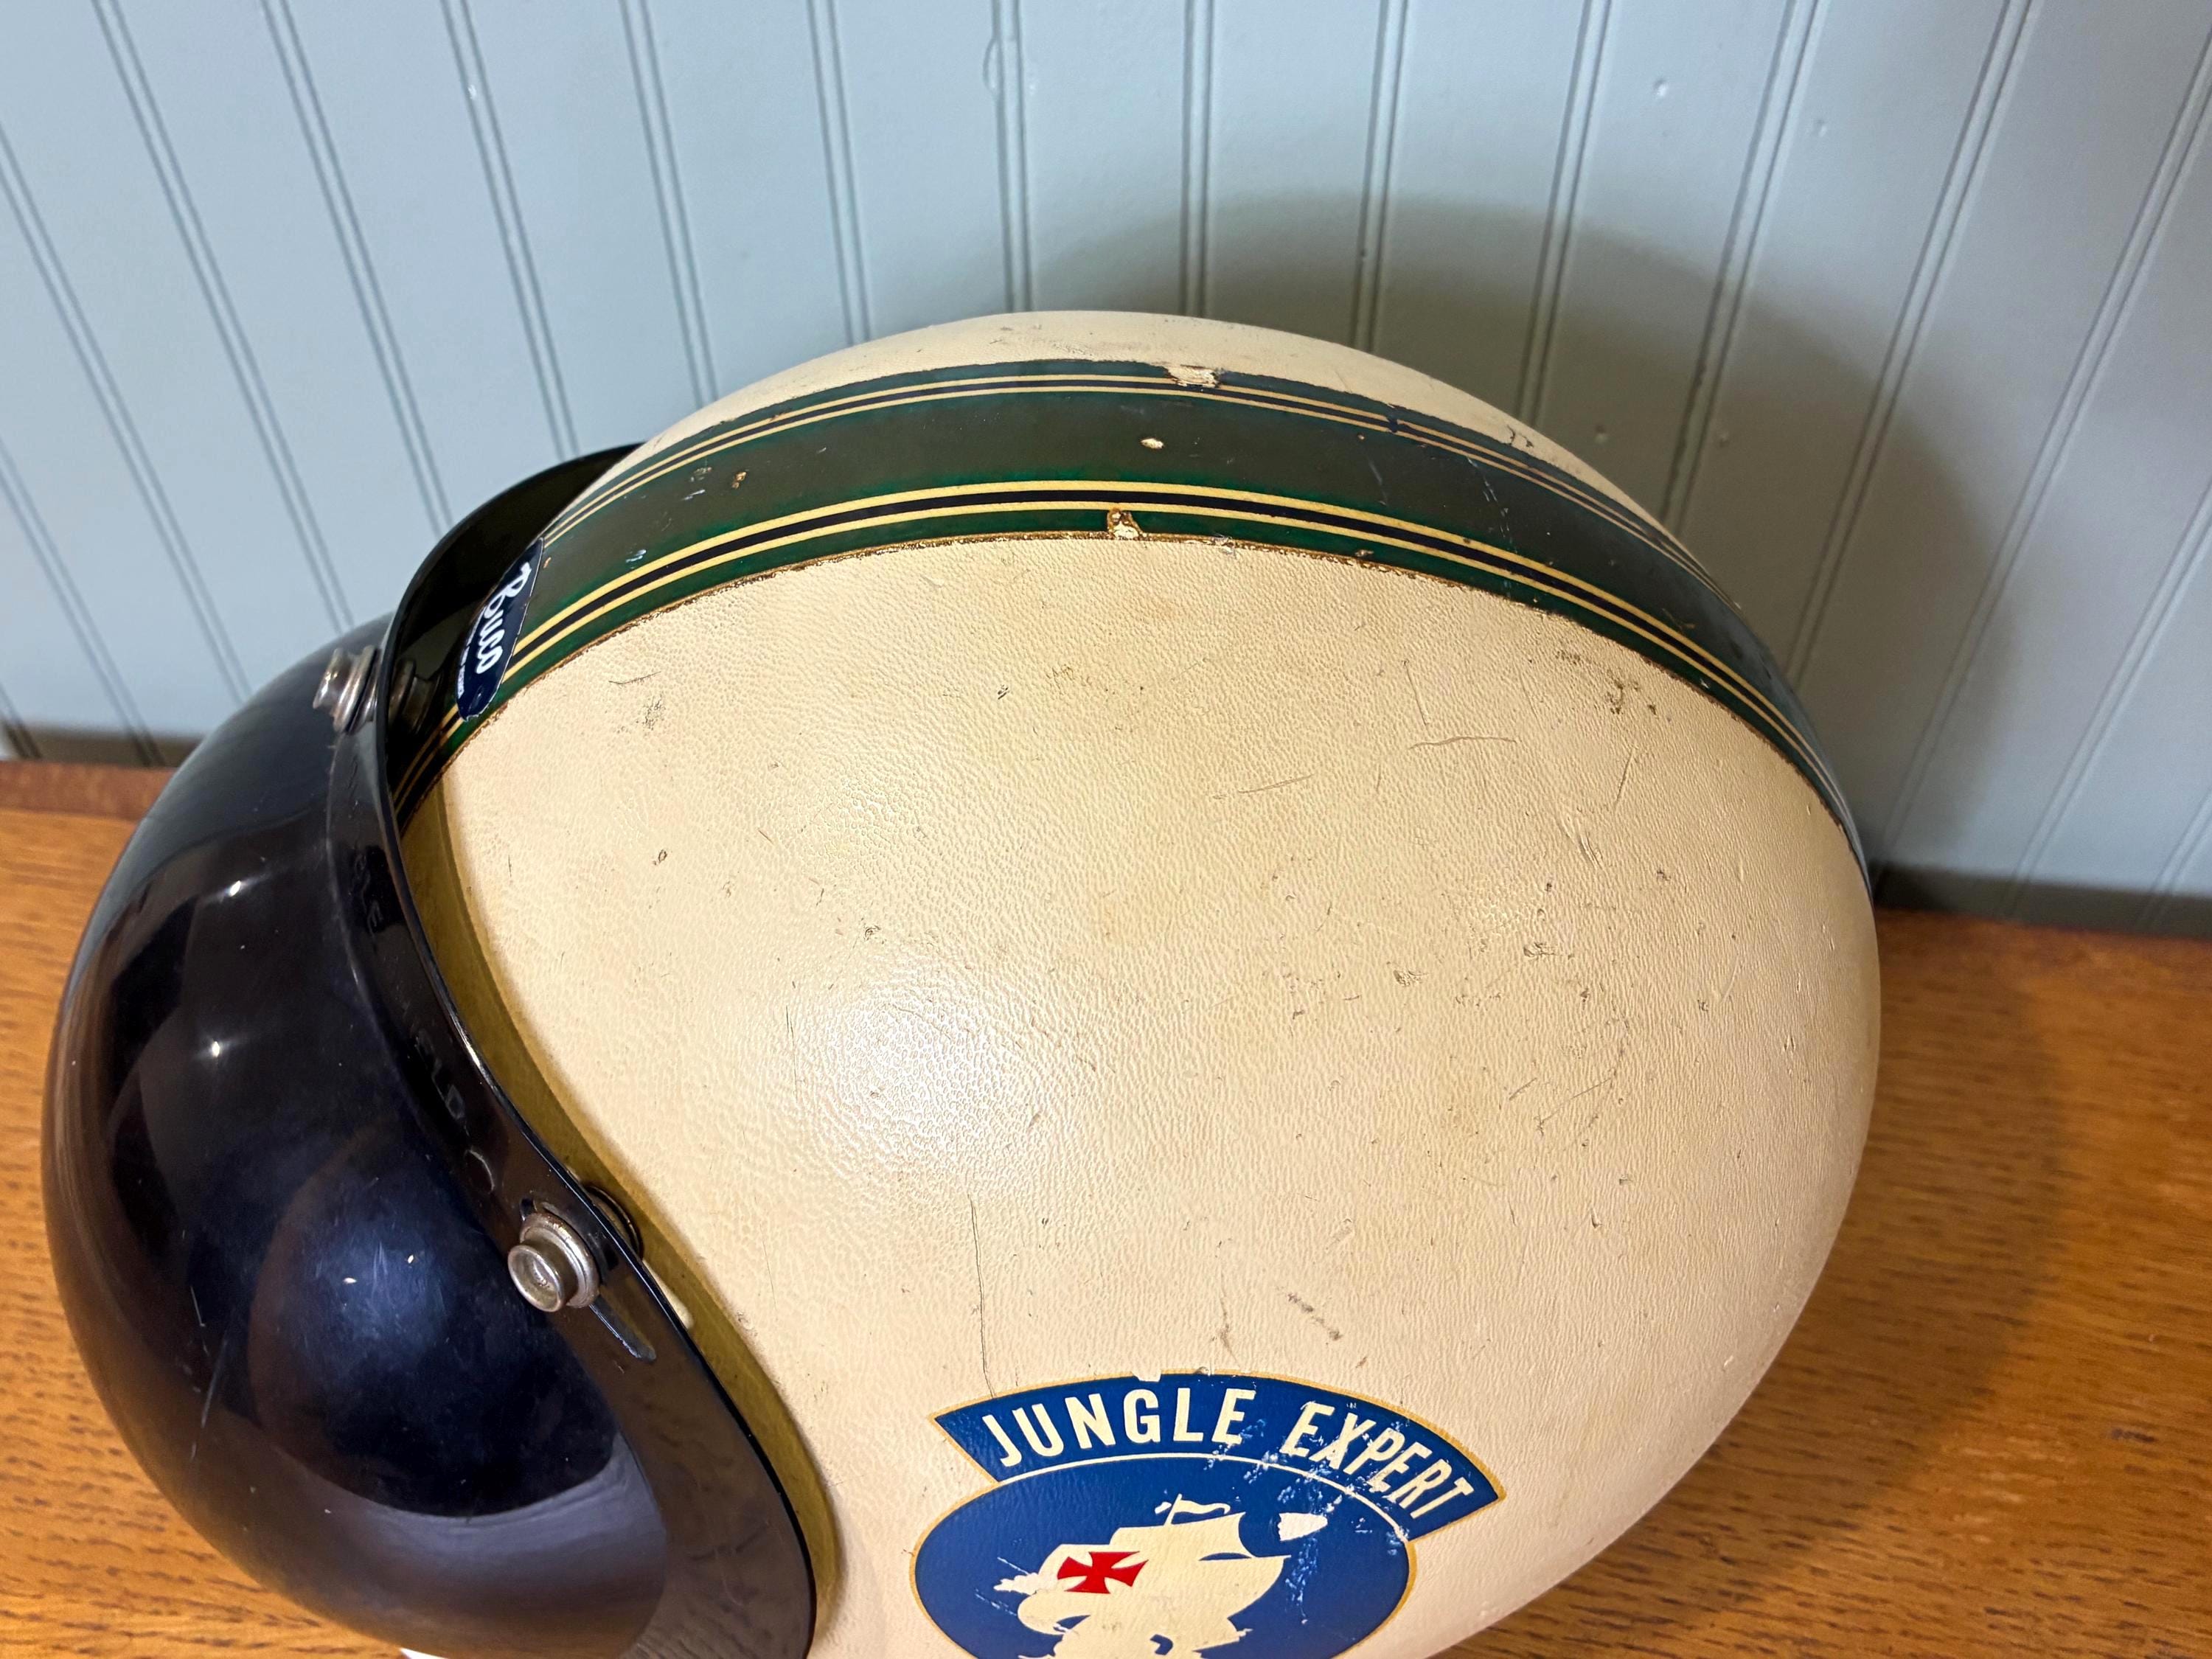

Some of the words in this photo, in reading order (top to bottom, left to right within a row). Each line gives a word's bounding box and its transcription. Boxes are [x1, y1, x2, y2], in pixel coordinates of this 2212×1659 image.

[475, 562, 532, 674] Buco
[981, 1387, 1256, 1467] JUNGLE
[1282, 1401, 1475, 1520] EXPERT
